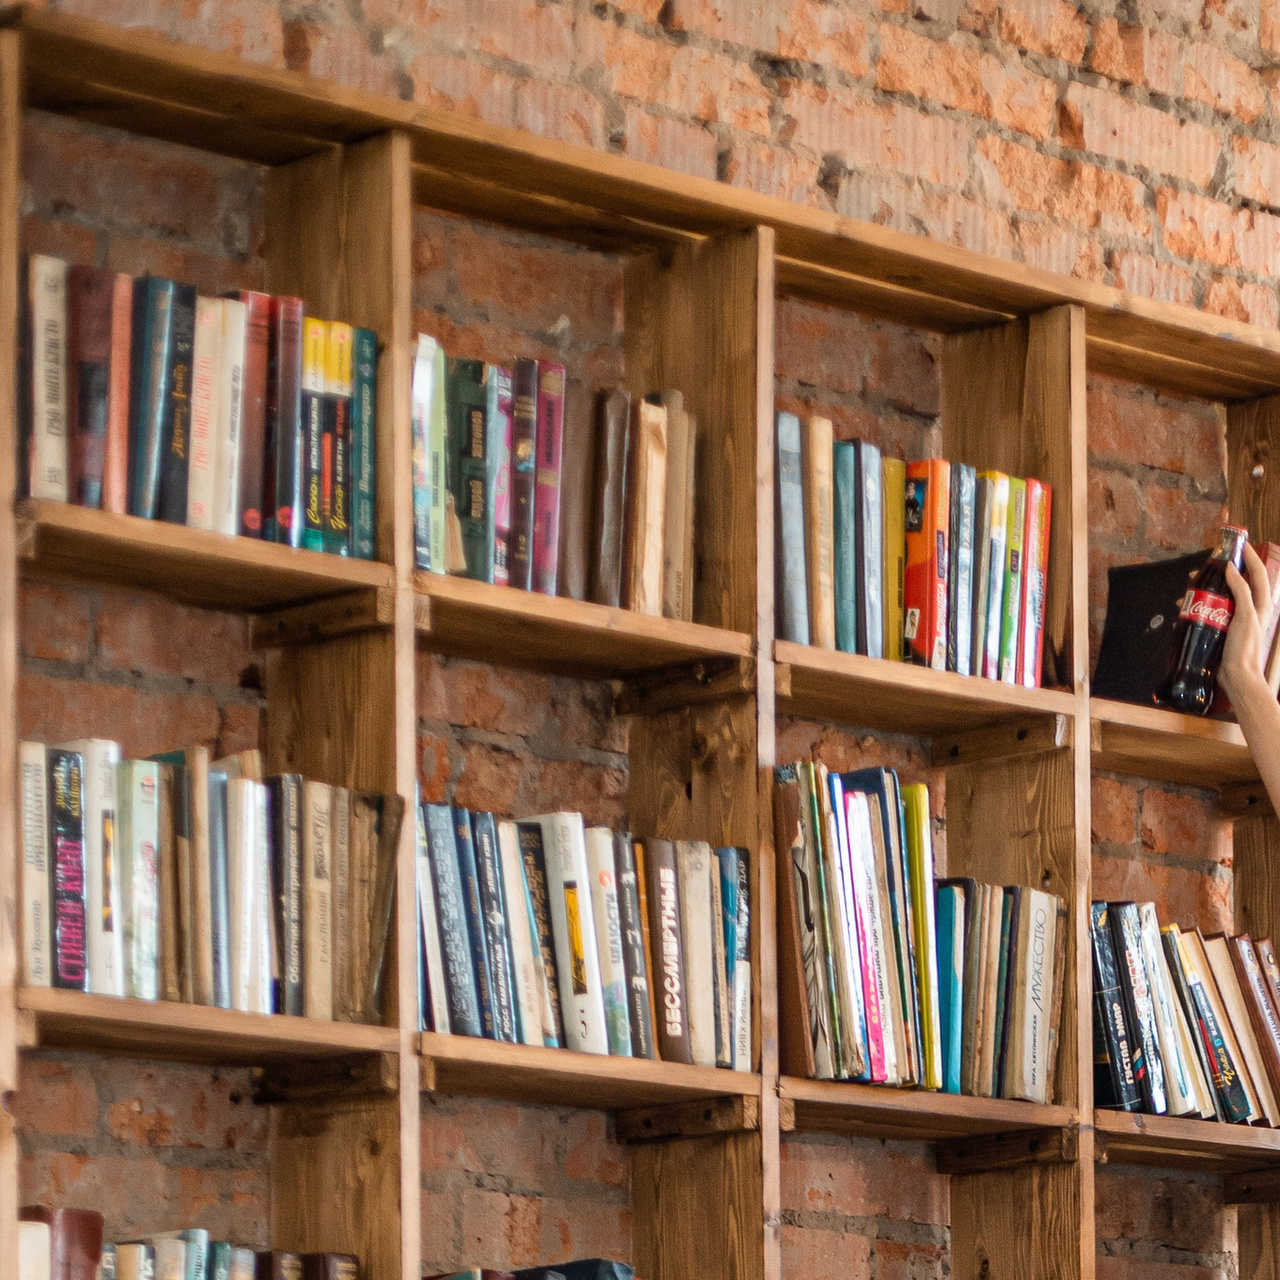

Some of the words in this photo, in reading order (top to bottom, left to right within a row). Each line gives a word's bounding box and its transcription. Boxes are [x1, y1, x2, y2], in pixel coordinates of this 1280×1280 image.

[56, 836, 82, 893] КИНГ
[287, 829, 300, 919] электрических
[482, 833, 492, 857] КВИН
[486, 858, 497, 893] ЭЛЛЕРИ
[57, 900, 83, 980] СТИВЕН
[288, 922, 301, 984] Обмотчик
[660, 868, 683, 1037] БЕССМЕРТНЫЕ
[1030, 908, 1046, 1012] МУЖЕСТВО
[494, 945, 509, 1007] МАКДОНАЛЬД
[502, 1008, 512, 1034] РОСС
[1113, 1002, 1126, 1036] ЭМАР
[1120, 1039, 1134, 1085] ГУСТАВ
